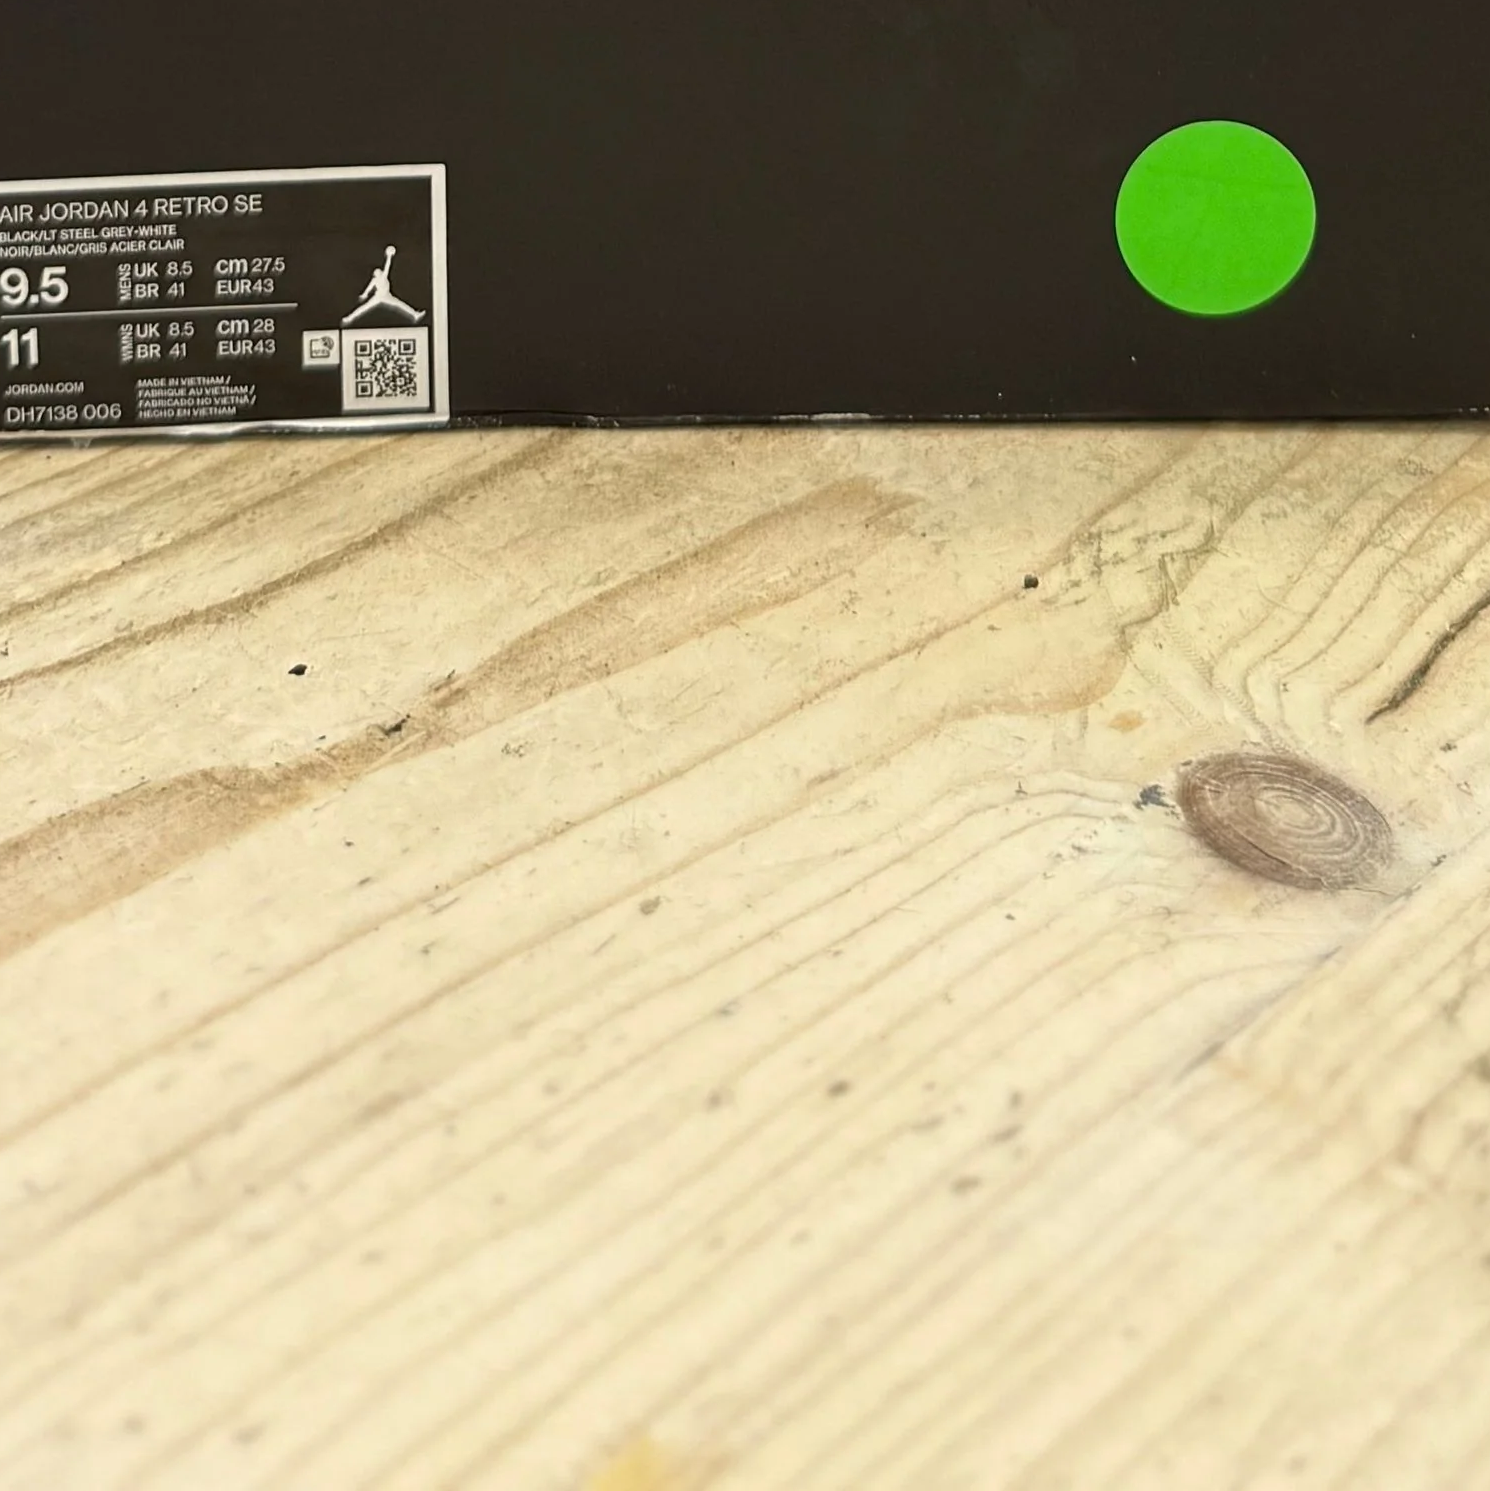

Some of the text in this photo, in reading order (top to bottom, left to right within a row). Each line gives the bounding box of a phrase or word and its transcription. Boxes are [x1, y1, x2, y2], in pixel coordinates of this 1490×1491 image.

[39, 199, 129, 222] JORDAN
[134, 199, 149, 218] 4
[154, 195, 229, 217] RETRO
[234, 193, 263, 213] SE
[59, 227, 99, 240] STEEL
[101, 224, 177, 238] GREY-WHITE
[110, 240, 147, 253] ACIER
[148, 238, 185, 251] CLAIR
[134, 260, 193, 278] UK 8.5
[216, 257, 286, 274] cm 27.5
[119, 263, 132, 301] MENS
[135, 281, 185, 299] BR 41
[136, 321, 195, 338] UK 8.5
[218, 318, 275, 335] cm 28
[0, 327, 40, 366] 11
[137, 342, 187, 359] BR 41
[5, 382, 85, 396] JORDAN.COM
[6, 403, 122, 424] DH7138 006
